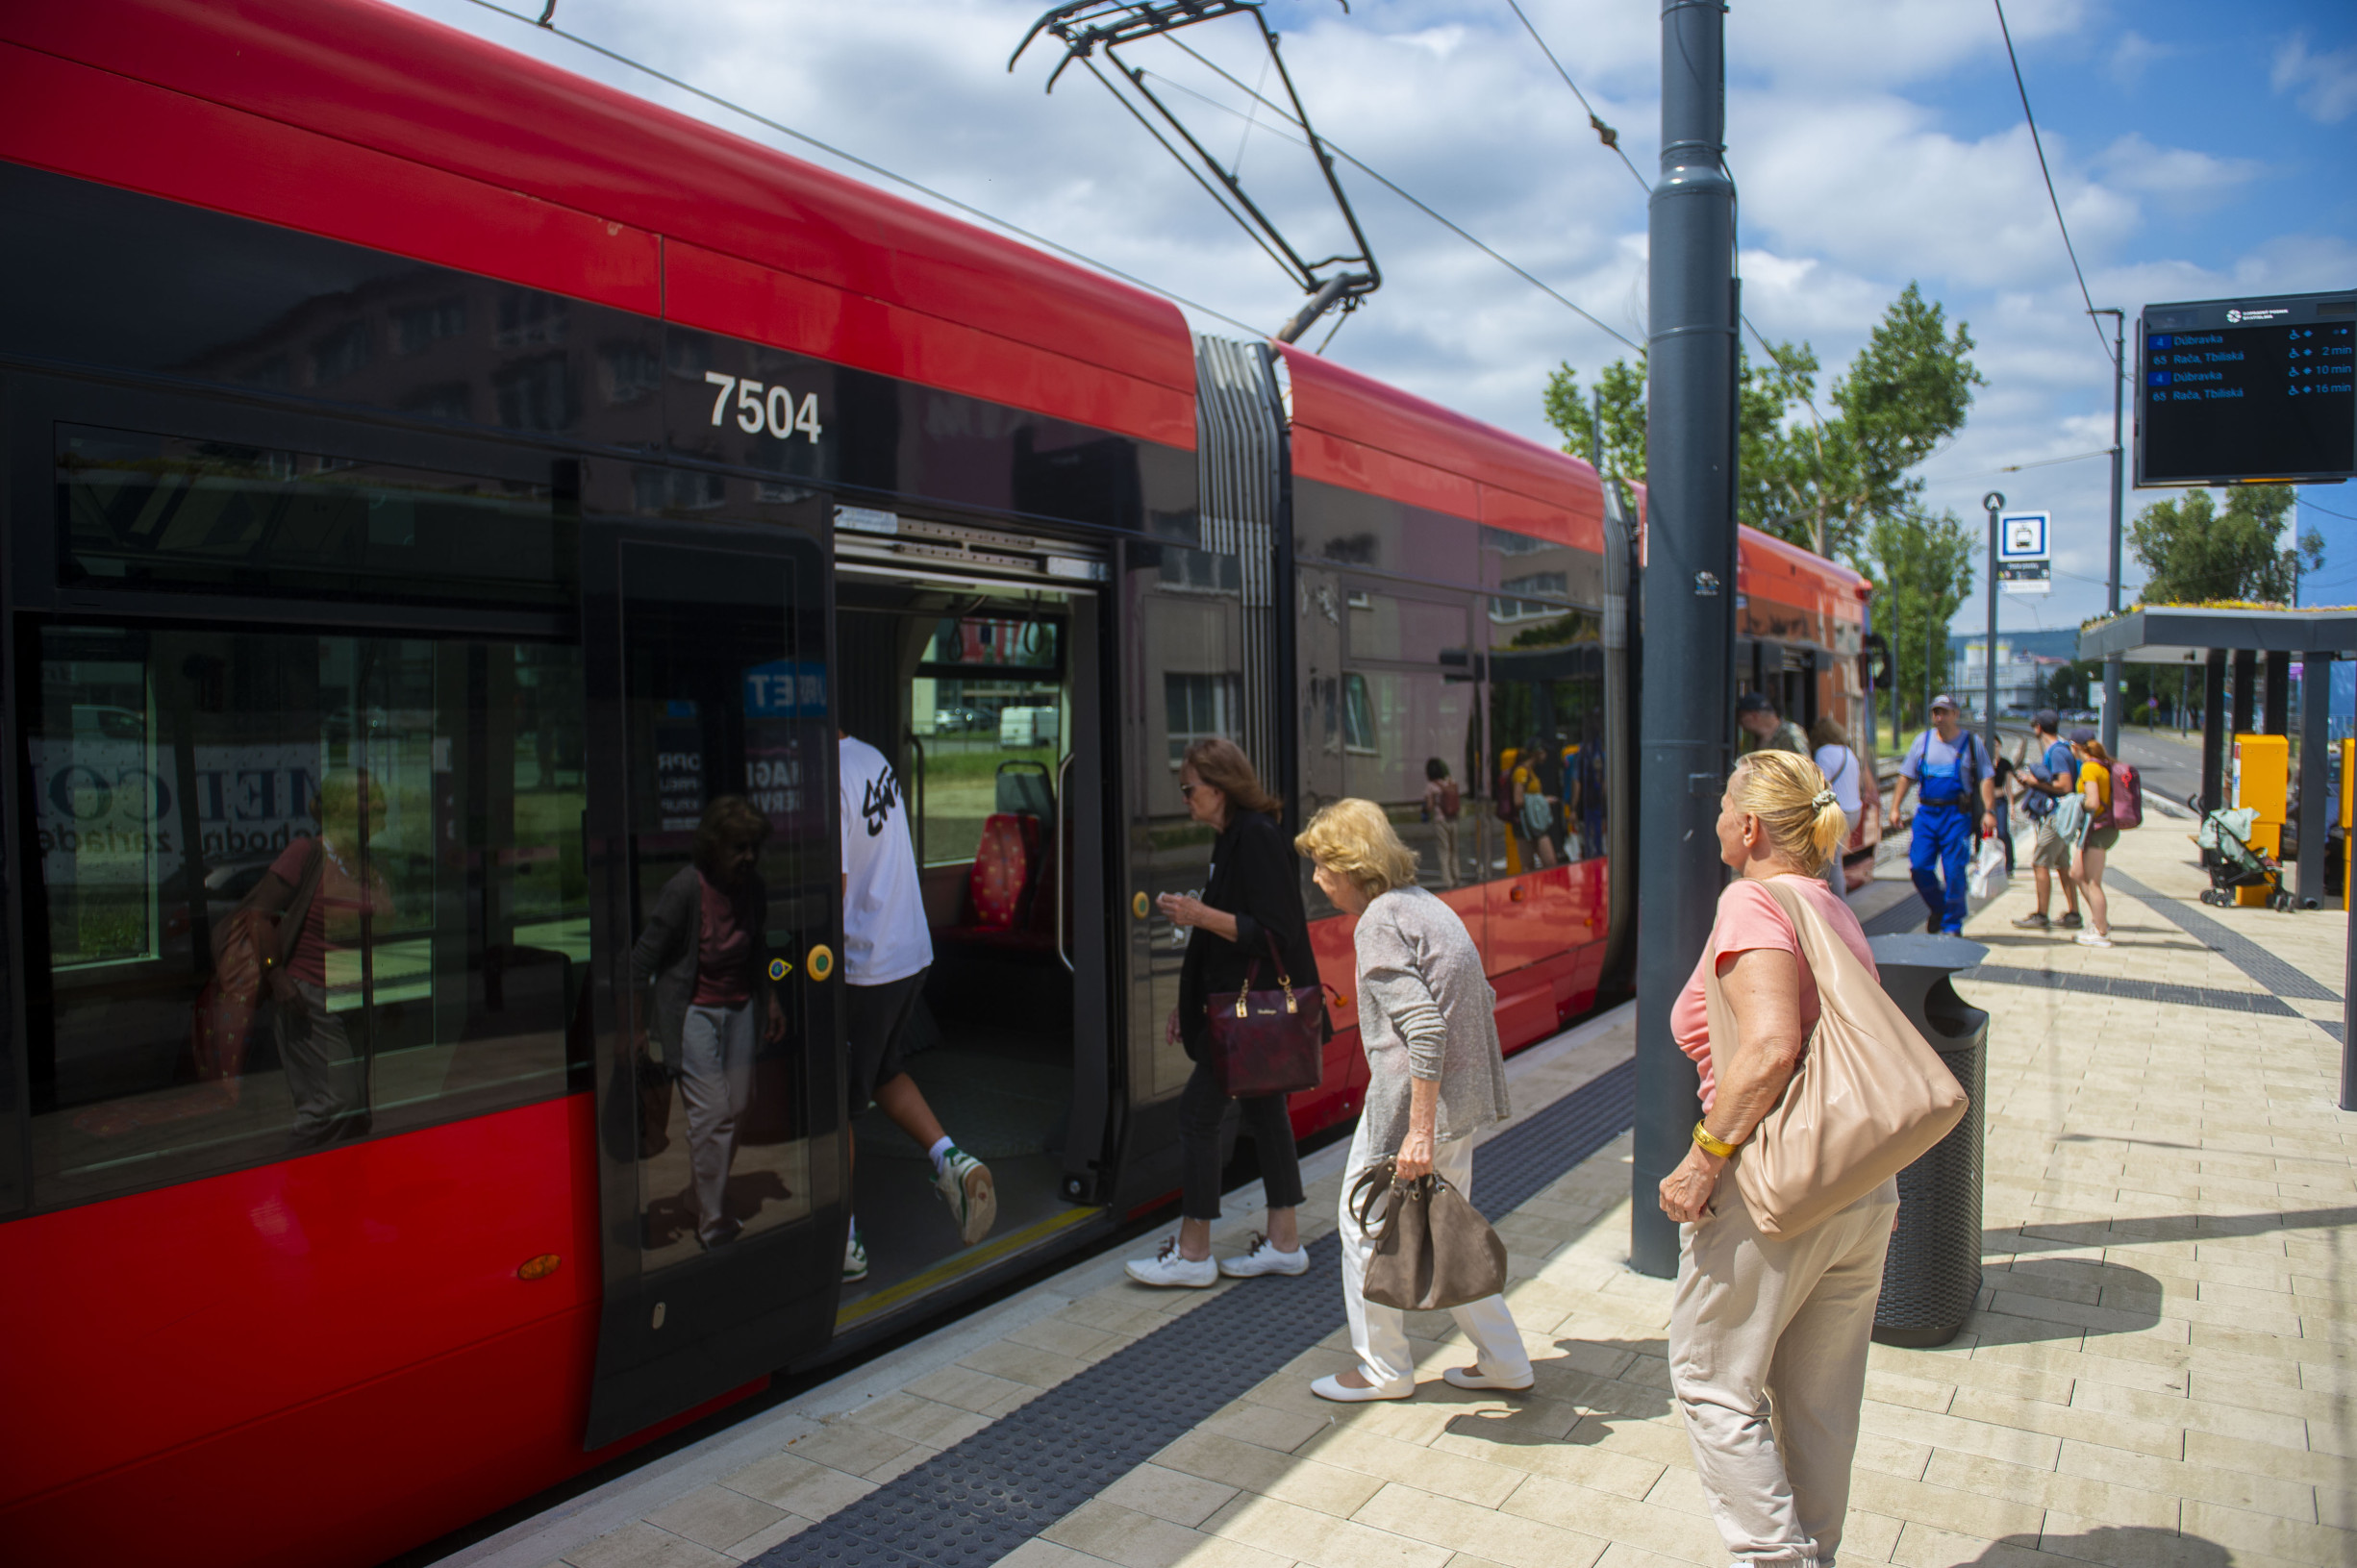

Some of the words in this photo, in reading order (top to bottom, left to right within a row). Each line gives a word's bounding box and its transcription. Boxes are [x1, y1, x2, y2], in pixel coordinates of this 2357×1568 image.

[2173, 334, 2223, 346] Dúbravka
[2173, 353, 2202, 364] Rača,
[2321, 347, 2330, 356] 2
[2331, 345, 2352, 356] min
[2172, 370, 2222, 383] Dúbravka
[2316, 364, 2329, 375] 10
[2330, 363, 2352, 374] min
[2172, 389, 2202, 401] Rača,
[2316, 384, 2329, 393] 16
[2330, 383, 2351, 392] min
[705, 370, 822, 444] 7504
